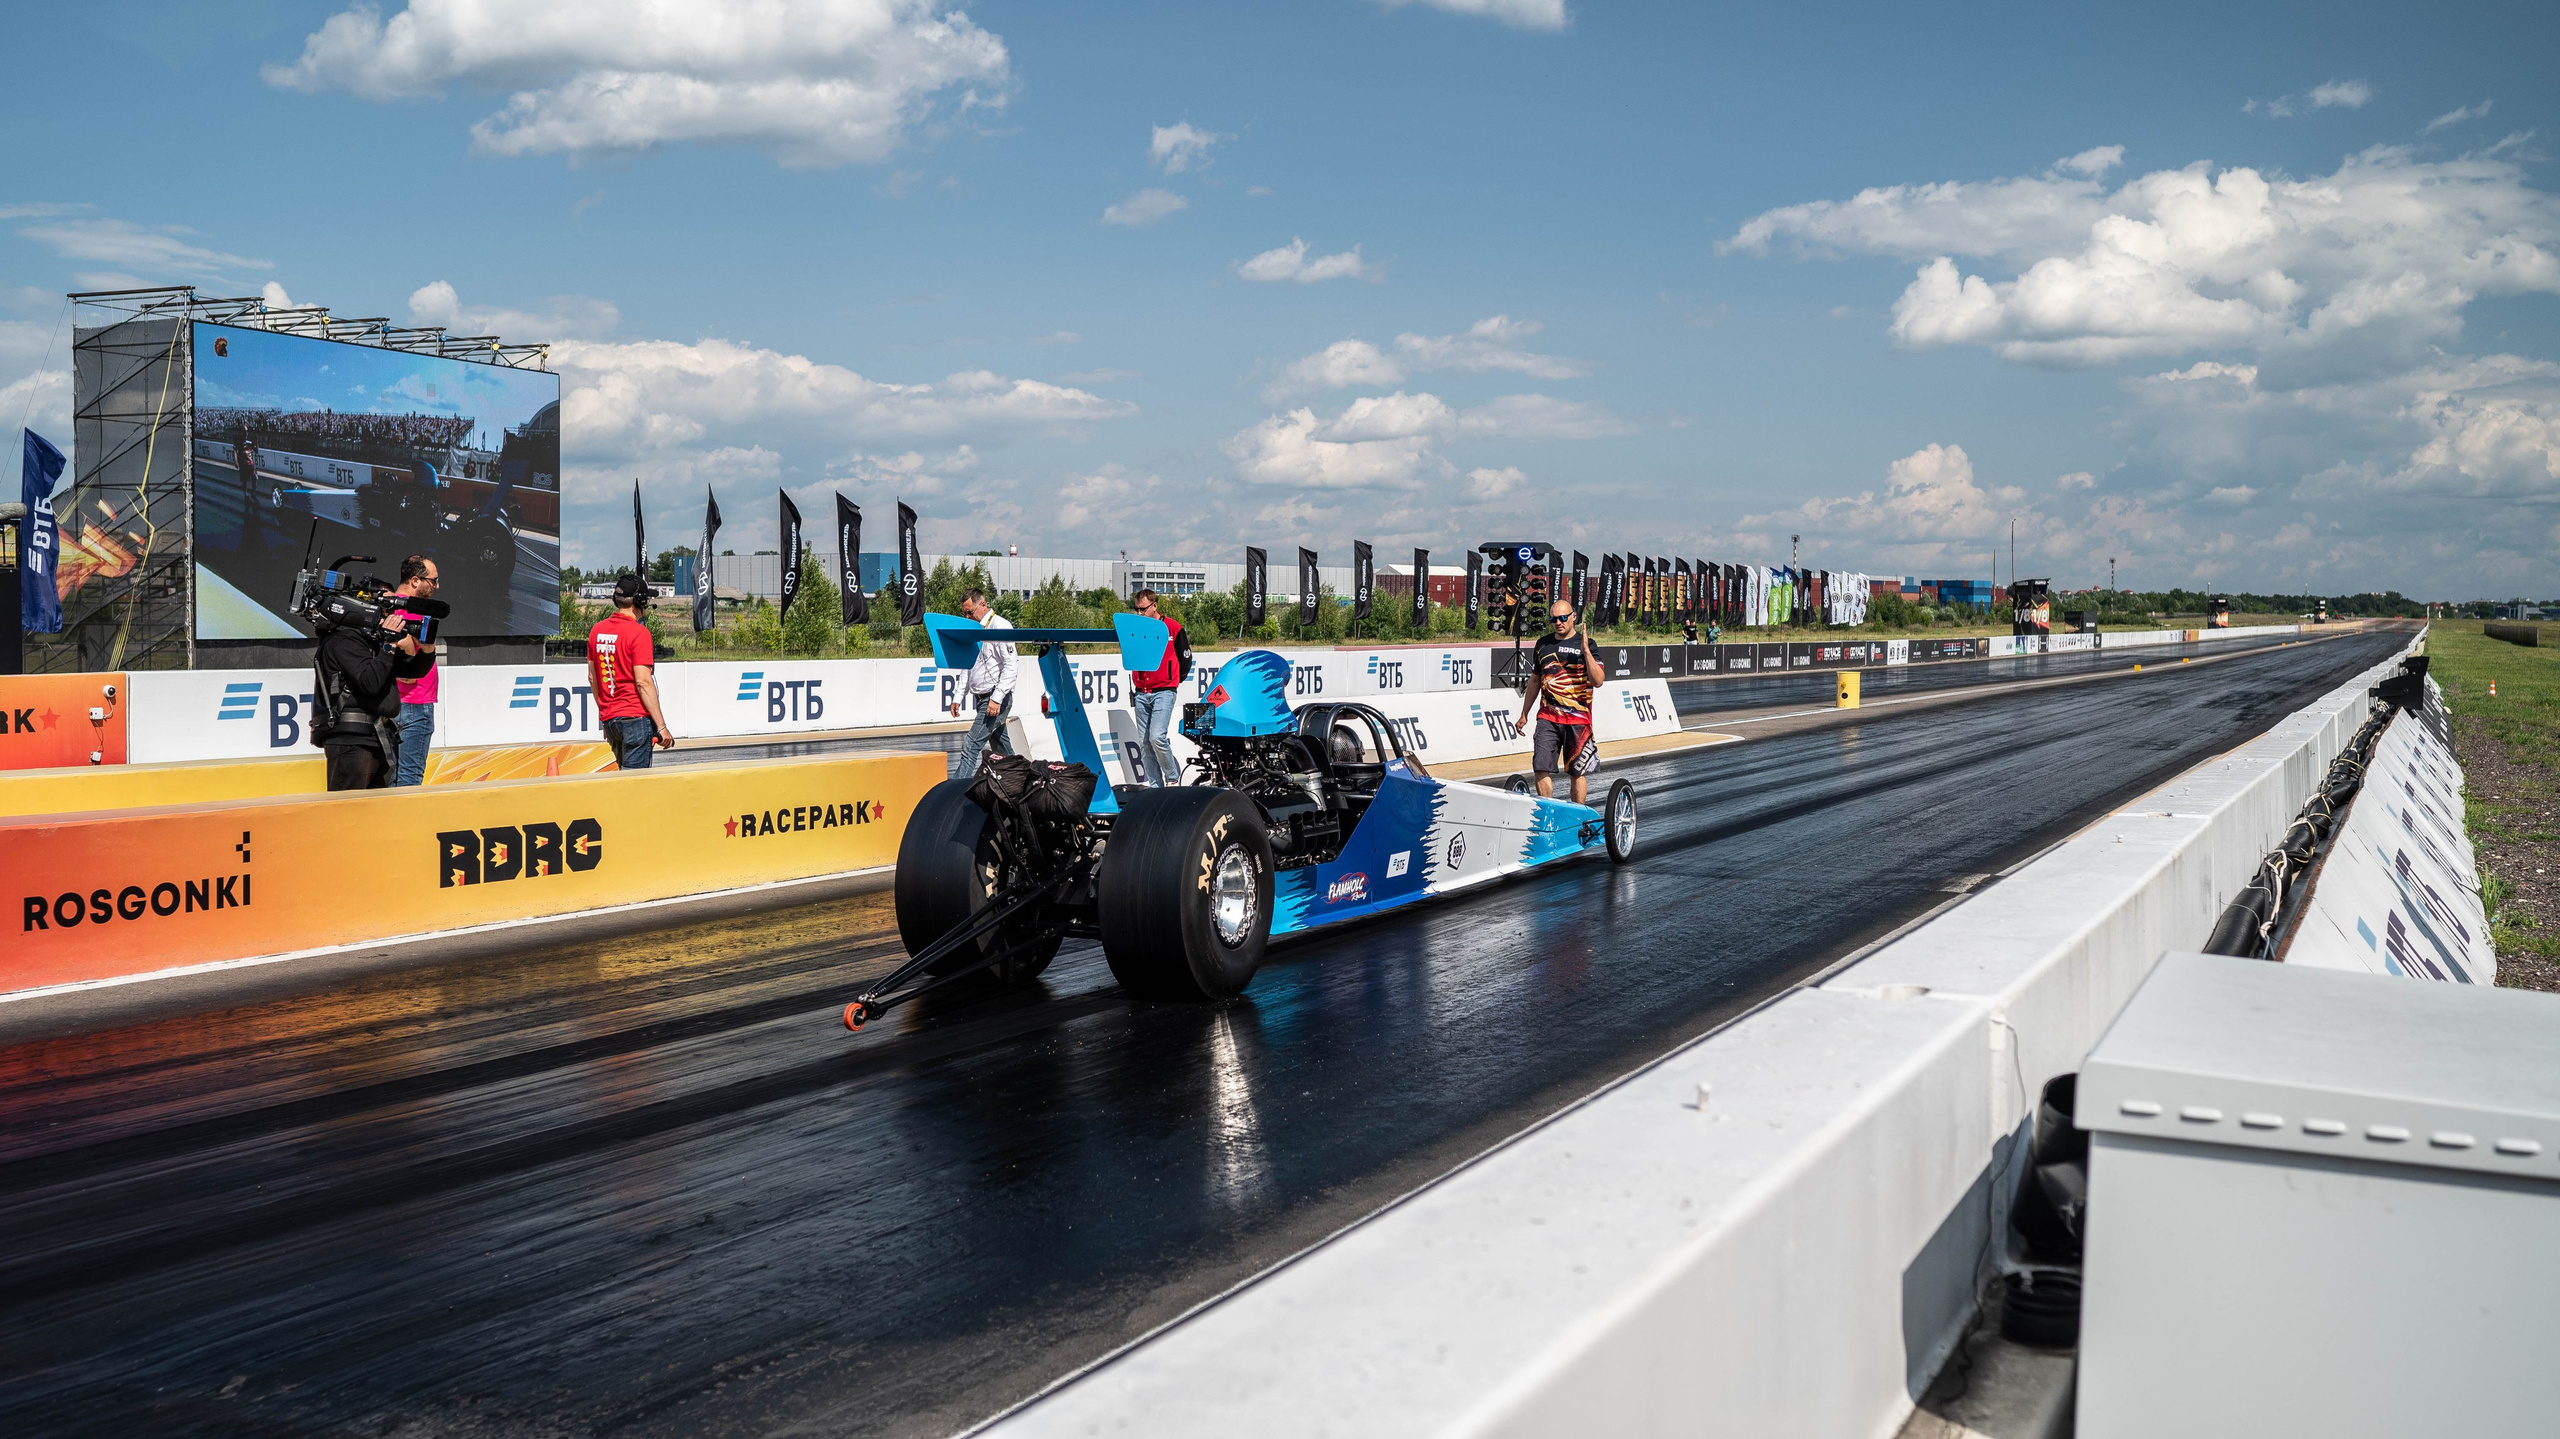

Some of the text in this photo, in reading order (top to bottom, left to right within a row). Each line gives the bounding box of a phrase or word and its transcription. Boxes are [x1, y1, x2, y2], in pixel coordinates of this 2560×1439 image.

[290, 460, 304, 475] ВТБ
[336, 468, 354, 484] ВТБ
[32, 495, 54, 549] ВТБ
[790, 522, 798, 568] НОРНИКЕЛЬ
[2013, 608, 2031, 624] 1/8
[2033, 608, 2048, 624] 1/8
[1082, 670, 1120, 704] ВТБ
[1295, 665, 1323, 696] ВТБ
[1379, 661, 1403, 689] ВТБ
[1452, 659, 1473, 685] ВТБ
[549, 686, 603, 733] ВТ
[767, 679, 824, 723] ВТБ
[1632, 695, 1657, 722] ВТБ
[1389, 716, 1428, 751] ВТБ
[1484, 709, 1517, 742] ВТБ
[740, 799, 871, 838] RACEPARK
[436, 817, 602, 889] RDRC
[23, 873, 251, 932] ROSGONKI
